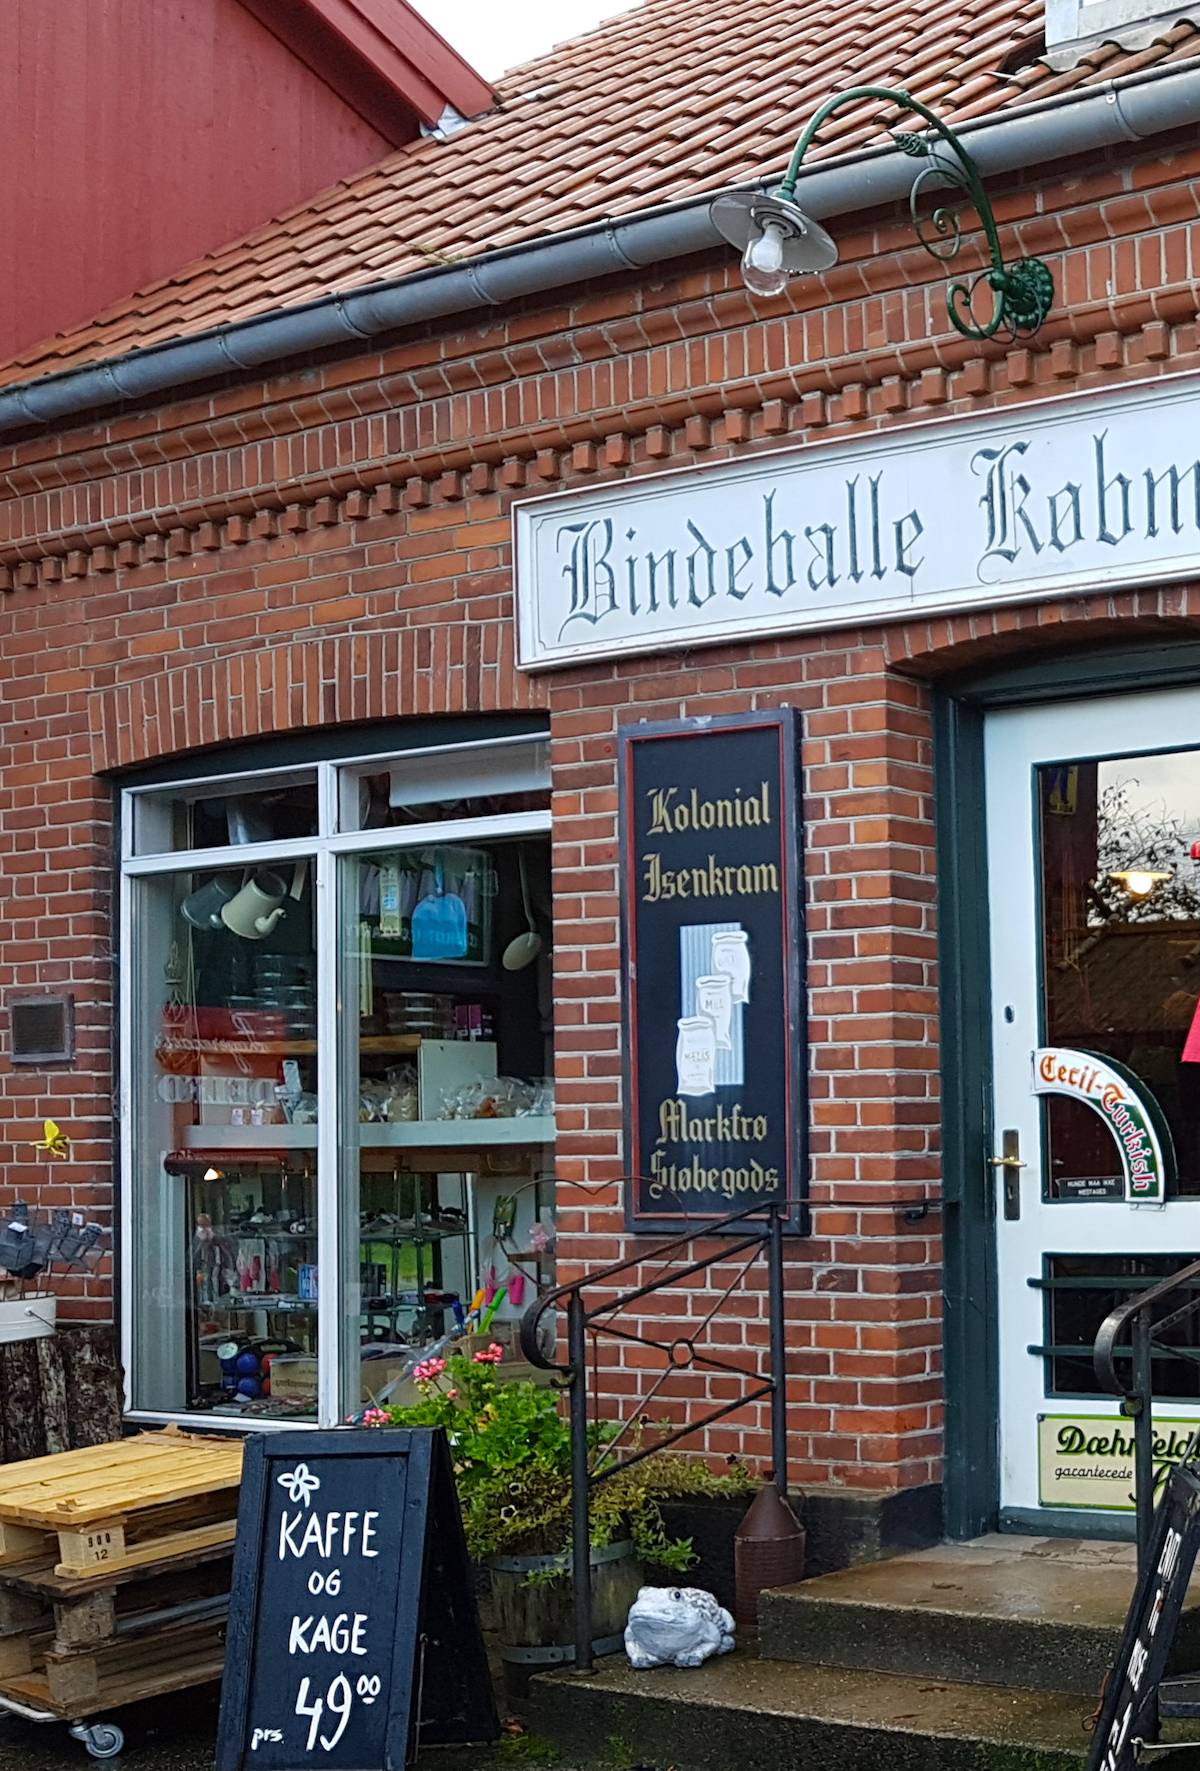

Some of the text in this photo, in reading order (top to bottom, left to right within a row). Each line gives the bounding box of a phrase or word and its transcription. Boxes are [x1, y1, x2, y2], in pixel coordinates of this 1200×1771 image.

[557, 470, 925, 642] Bindeballe
[646, 781, 770, 835] Kolonial
[642, 853, 778, 902] Isenkram
[656, 1099, 768, 1145] Markfrø
[649, 1149, 779, 1199] Støbegods
[95, 1549, 109, 1561] 12
[279, 1510, 379, 1560] KAFFE
[308, 1569, 342, 1596] OG
[289, 1612, 368, 1655] KAGE
